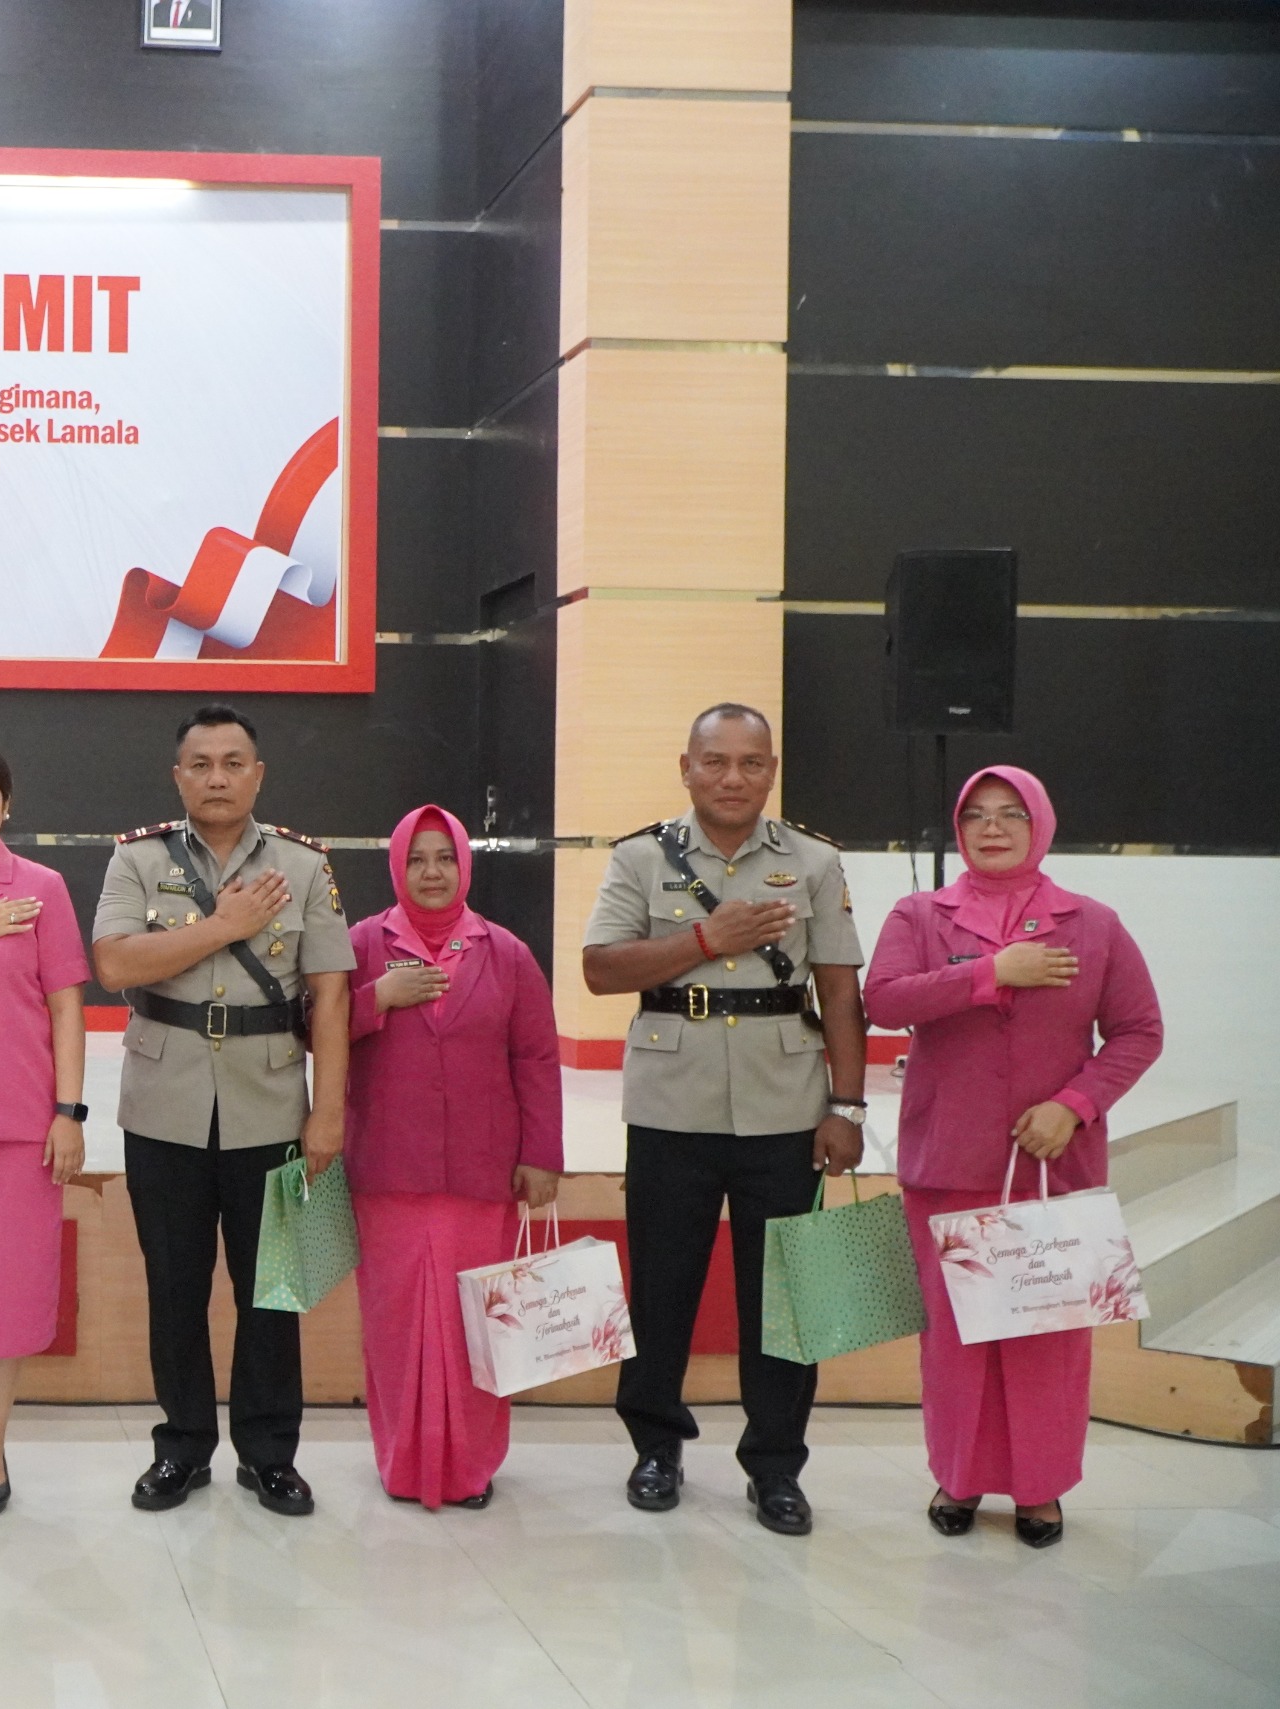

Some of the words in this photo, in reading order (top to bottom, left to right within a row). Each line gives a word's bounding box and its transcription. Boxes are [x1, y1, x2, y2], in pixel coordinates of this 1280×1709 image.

[47, 419, 139, 446] Lamala
[1030, 1237, 1081, 1256] Berkenan
[1028, 1259, 1045, 1270] dan
[1010, 1267, 1073, 1292] Terimakasih
[548, 1308, 561, 1319] dan
